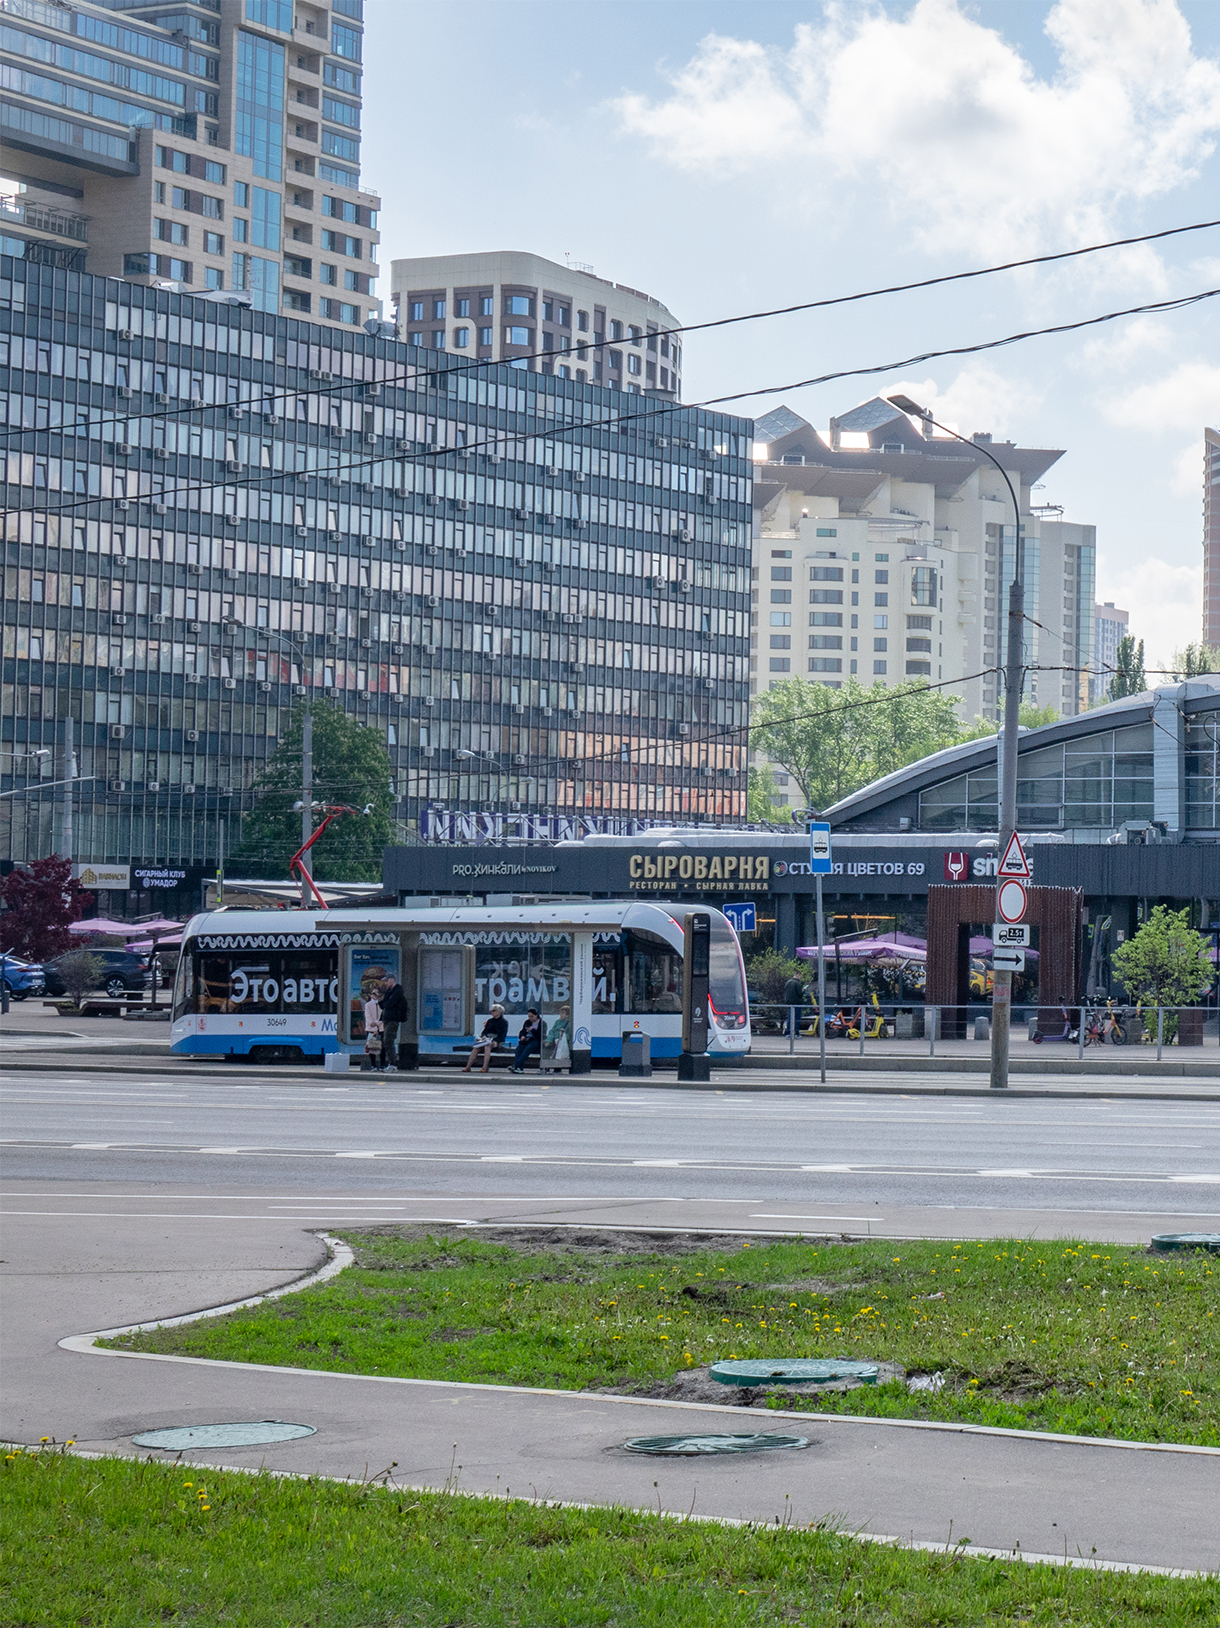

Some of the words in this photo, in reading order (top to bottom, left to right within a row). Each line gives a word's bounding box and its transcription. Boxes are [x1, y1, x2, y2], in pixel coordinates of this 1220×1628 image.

[527, 865, 557, 873] NOVIKOV
[629, 855, 770, 879] СЫРОВАРНЯ
[788, 862, 844, 876] СТУЯ
[847, 862, 904, 877] ЦВЕТОВ
[907, 862, 925, 875] 69
[134, 869, 168, 878] СИГАРНЫЙ
[169, 870, 186, 878] КЛУБ
[629, 881, 677, 890] РЕСТОРАН
[696, 882, 734, 890] СЫРНАЯ
[738, 882, 769, 891] ЛАВКА
[230, 970, 279, 1003] Это
[267, 1018, 287, 1027] 30649
